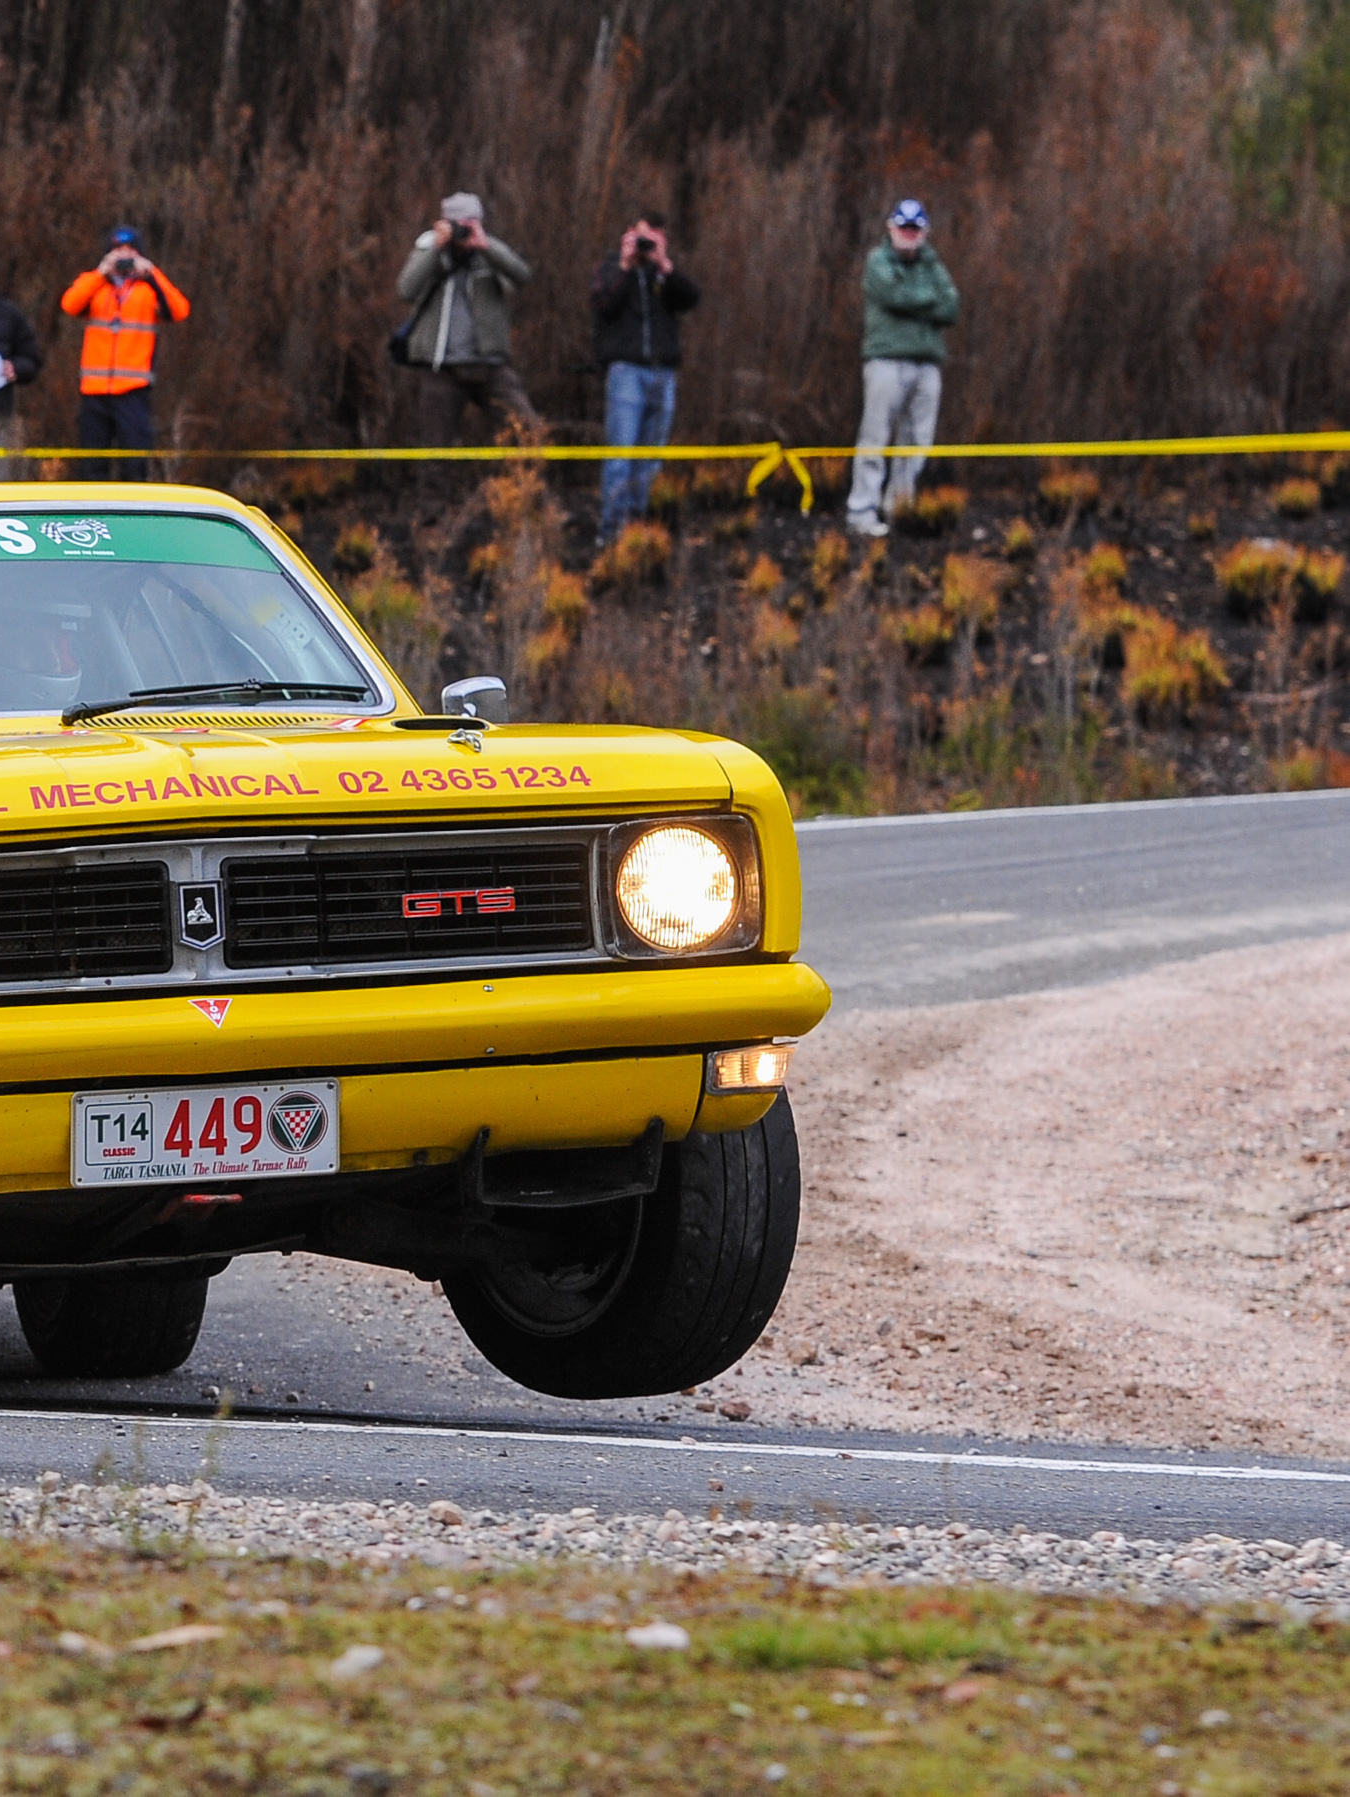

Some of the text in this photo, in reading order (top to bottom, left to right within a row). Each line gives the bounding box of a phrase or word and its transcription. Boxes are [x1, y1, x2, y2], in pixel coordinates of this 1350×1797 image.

[30, 772, 320, 809] MECHANICAL
[338, 770, 389, 795] 02
[401, 886, 516, 918] GTS
[206, 1000, 221, 1021] TOW
[90, 1095, 262, 1158] T14 449
[103, 1146, 136, 1158] CLASSIC
[103, 1156, 309, 1180] TARGA TASMANIA The Ultimate Tarmac Rally
